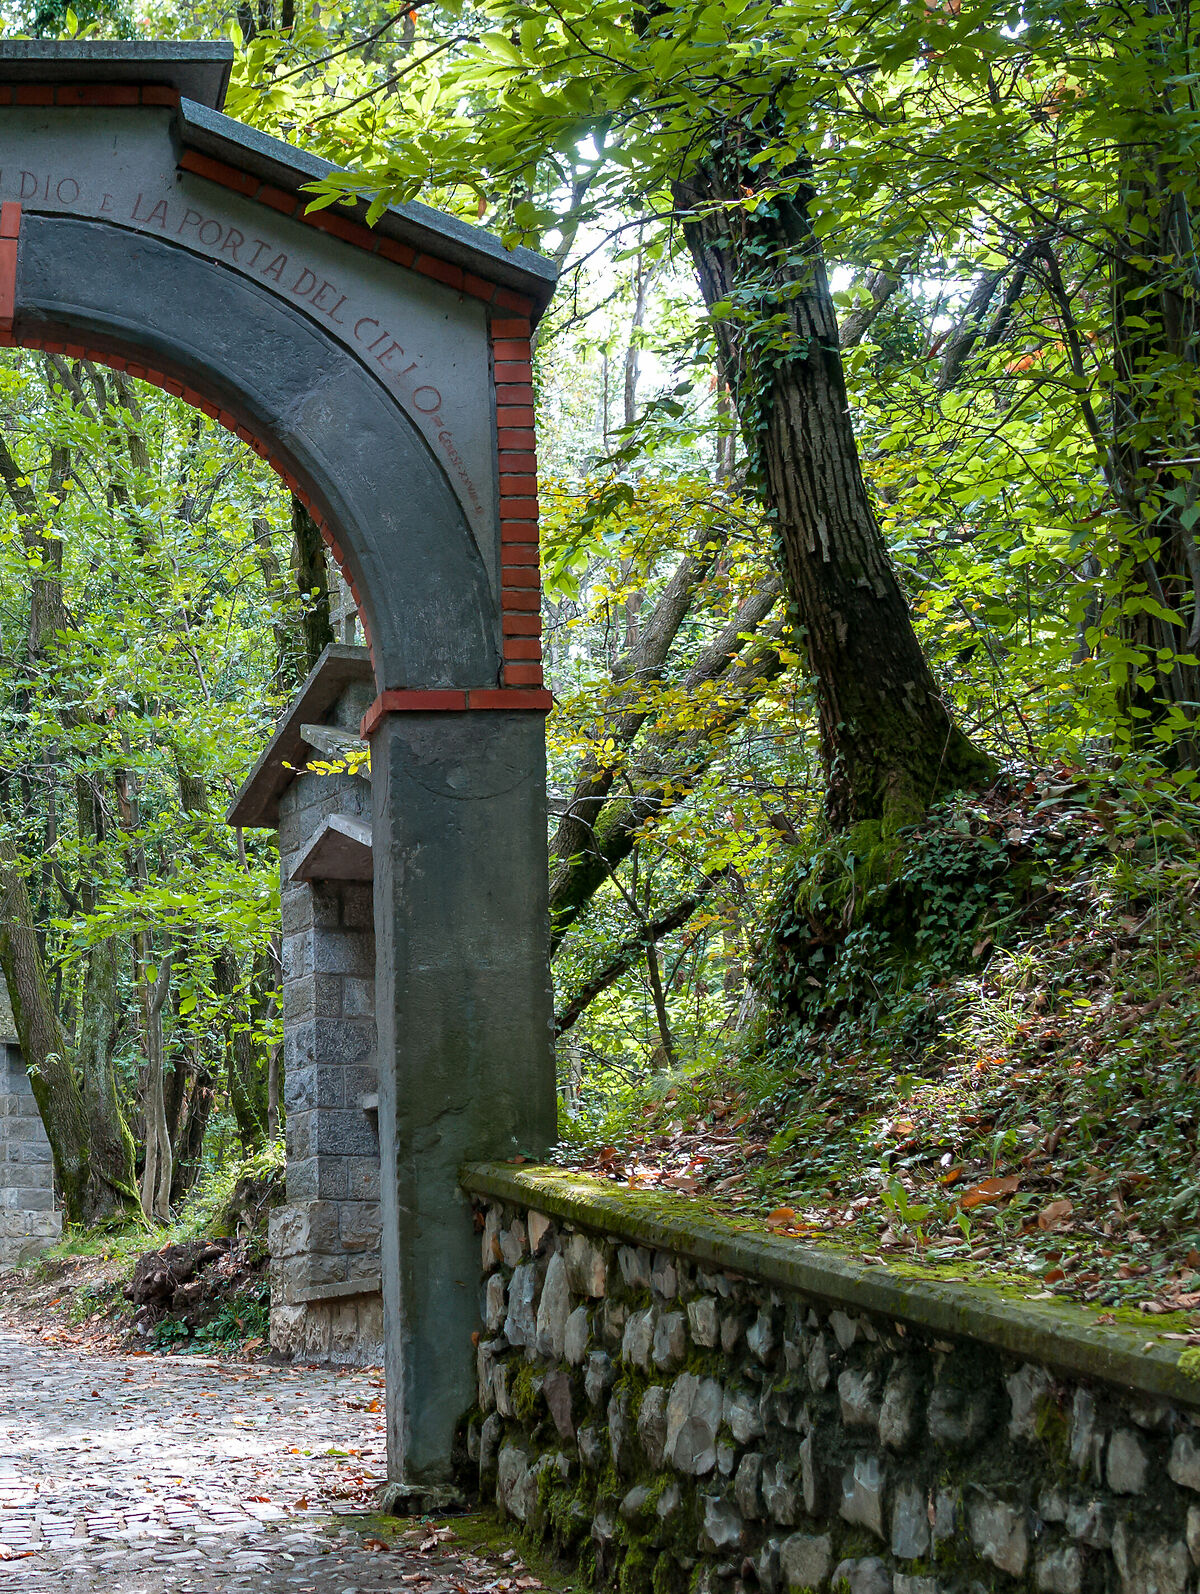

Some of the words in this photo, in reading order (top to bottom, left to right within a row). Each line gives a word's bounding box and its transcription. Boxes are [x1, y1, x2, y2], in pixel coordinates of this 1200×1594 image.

[19, 170, 80, 205] DIO
[98, 192, 114, 212] E
[130, 192, 169, 229] LA
[175, 207, 288, 283] PORTA
[290, 267, 348, 324] DEL
